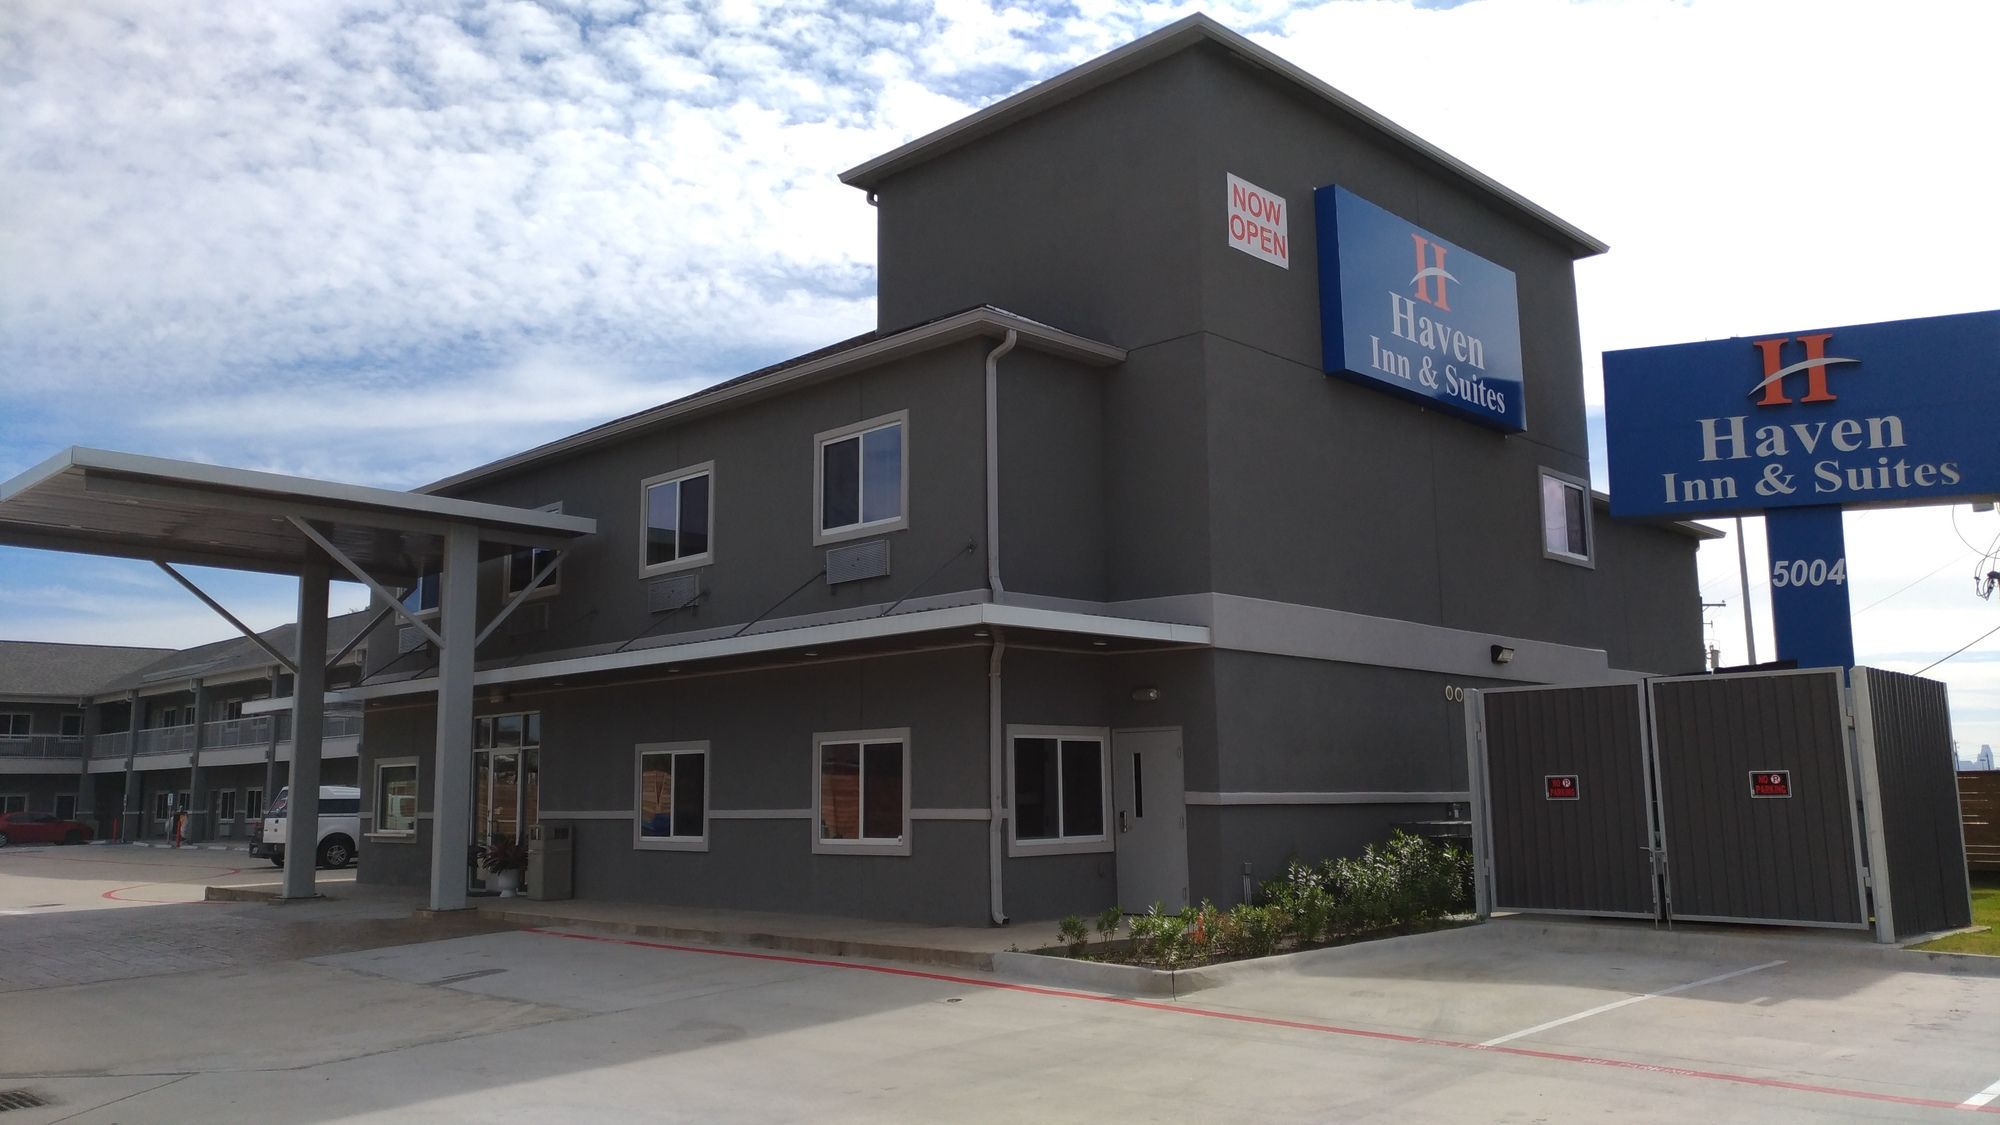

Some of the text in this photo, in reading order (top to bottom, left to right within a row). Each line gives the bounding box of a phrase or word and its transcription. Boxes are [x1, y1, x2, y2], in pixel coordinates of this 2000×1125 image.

[1233, 183, 1281, 226] NOW
[1230, 214, 1286, 259] OPEN
[1411, 233, 1451, 312] H
[1388, 290, 1485, 370] Haven
[1369, 335, 1505, 414] Inn & Suites
[1753, 333, 1837, 406] H
[1696, 415, 1907, 462] Haven
[1661, 457, 1961, 504] Inn & Suites
[1772, 558, 1846, 588] 5004
[1755, 785, 1786, 794] PARKING
